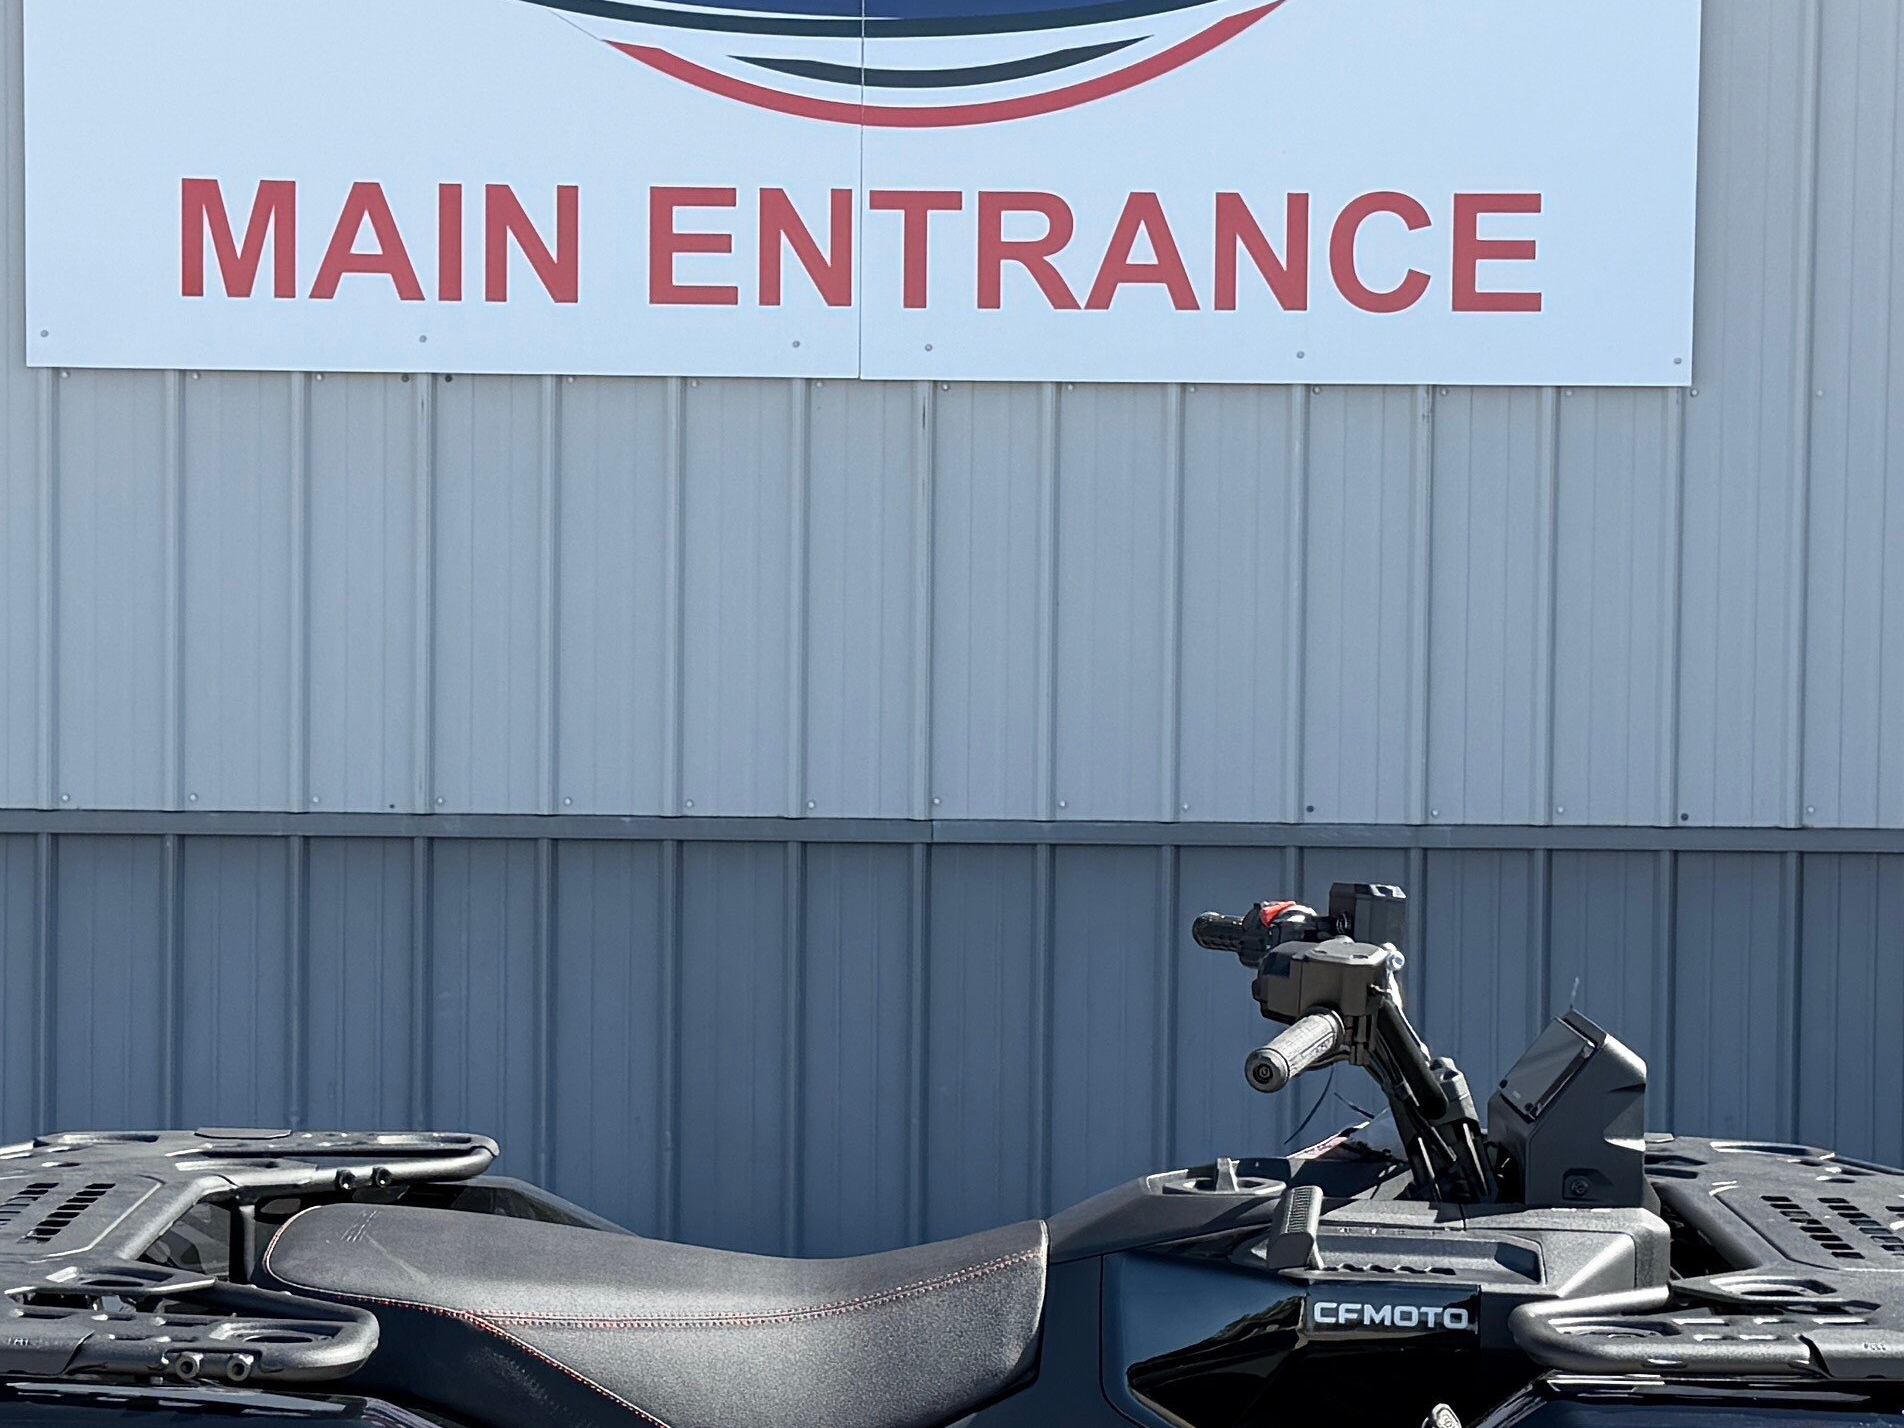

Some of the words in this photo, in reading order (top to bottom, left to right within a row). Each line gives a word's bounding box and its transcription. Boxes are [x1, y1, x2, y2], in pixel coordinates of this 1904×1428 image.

[182, 179, 579, 303] MAIN
[650, 187, 1542, 313] ENTRANCE
[1313, 1301, 1470, 1330] CFMOTO
